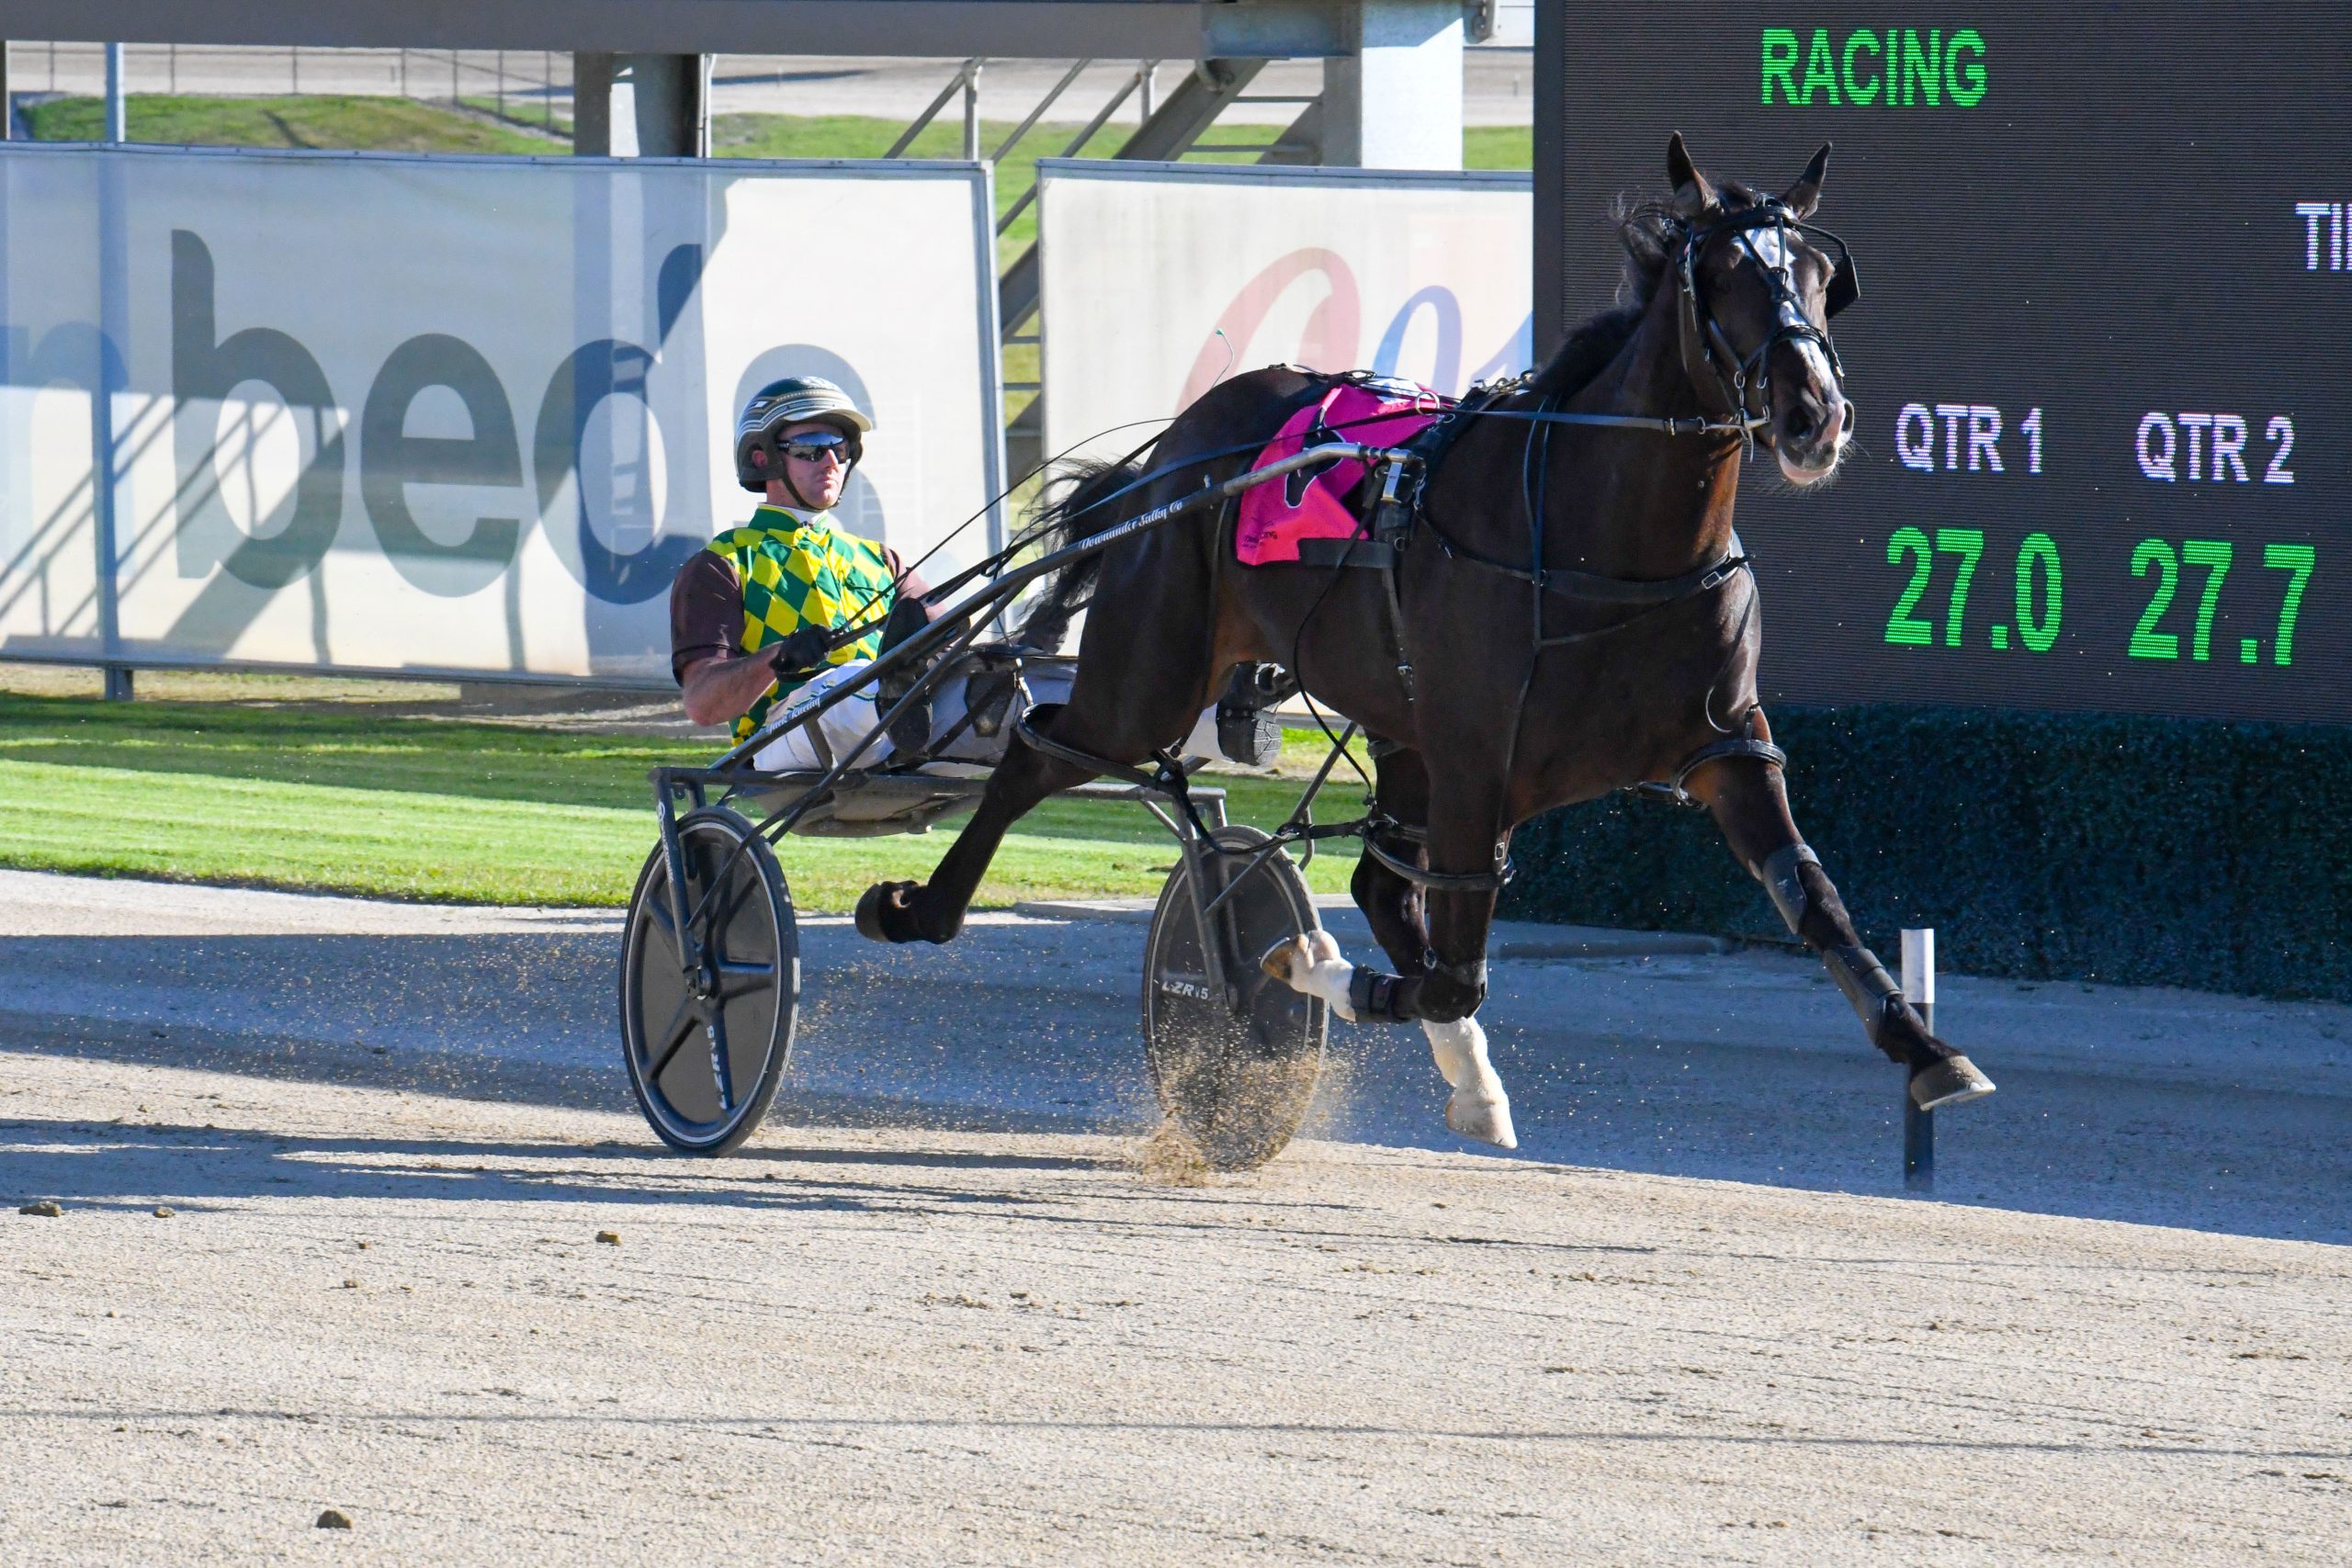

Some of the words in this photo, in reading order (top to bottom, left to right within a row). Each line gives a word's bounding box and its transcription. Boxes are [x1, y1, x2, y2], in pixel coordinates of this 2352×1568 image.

[1761, 28, 1987, 107] RACING
[2295, 202, 2352, 271] TI
[1894, 404, 2005, 472] QTR
[2021, 408, 2043, 474] 1
[2136, 412, 2249, 483] QTR
[2264, 417, 2295, 484] 2
[1079, 520, 1138, 550] Downunder
[1884, 526, 2064, 652] 27.0
[2128, 538, 2315, 665] 27.7
